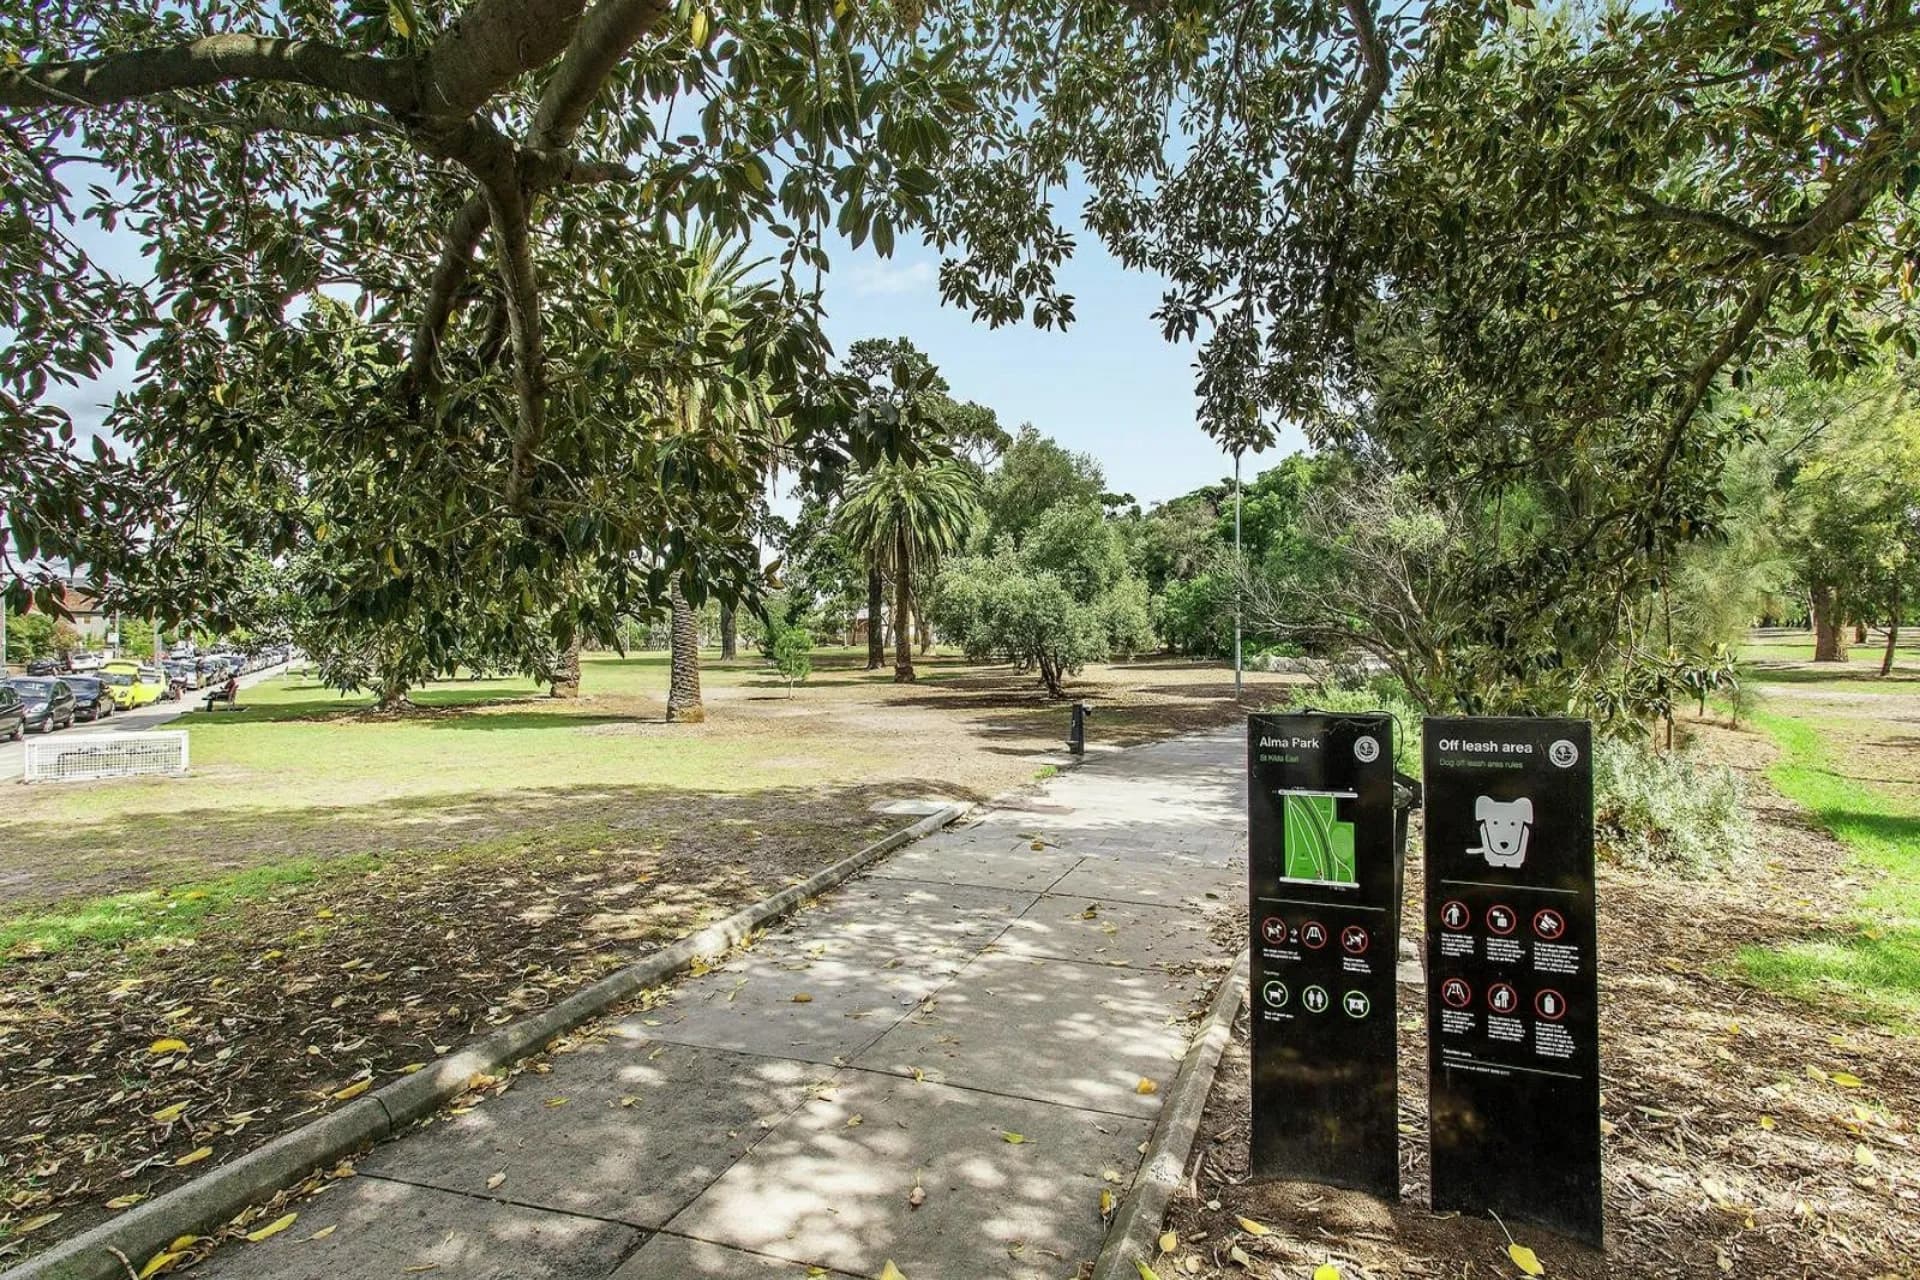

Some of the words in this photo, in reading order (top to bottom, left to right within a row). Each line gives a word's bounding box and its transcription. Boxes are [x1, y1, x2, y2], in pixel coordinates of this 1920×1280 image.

[1260, 736, 1288, 748] Alma
[1292, 737, 1319, 749] Park
[1439, 739, 1459, 751] Off
[1462, 740, 1498, 752] leash
[1502, 744, 1533, 753] area
[1439, 758, 1454, 768] Dog
[1455, 759, 1466, 767] off
